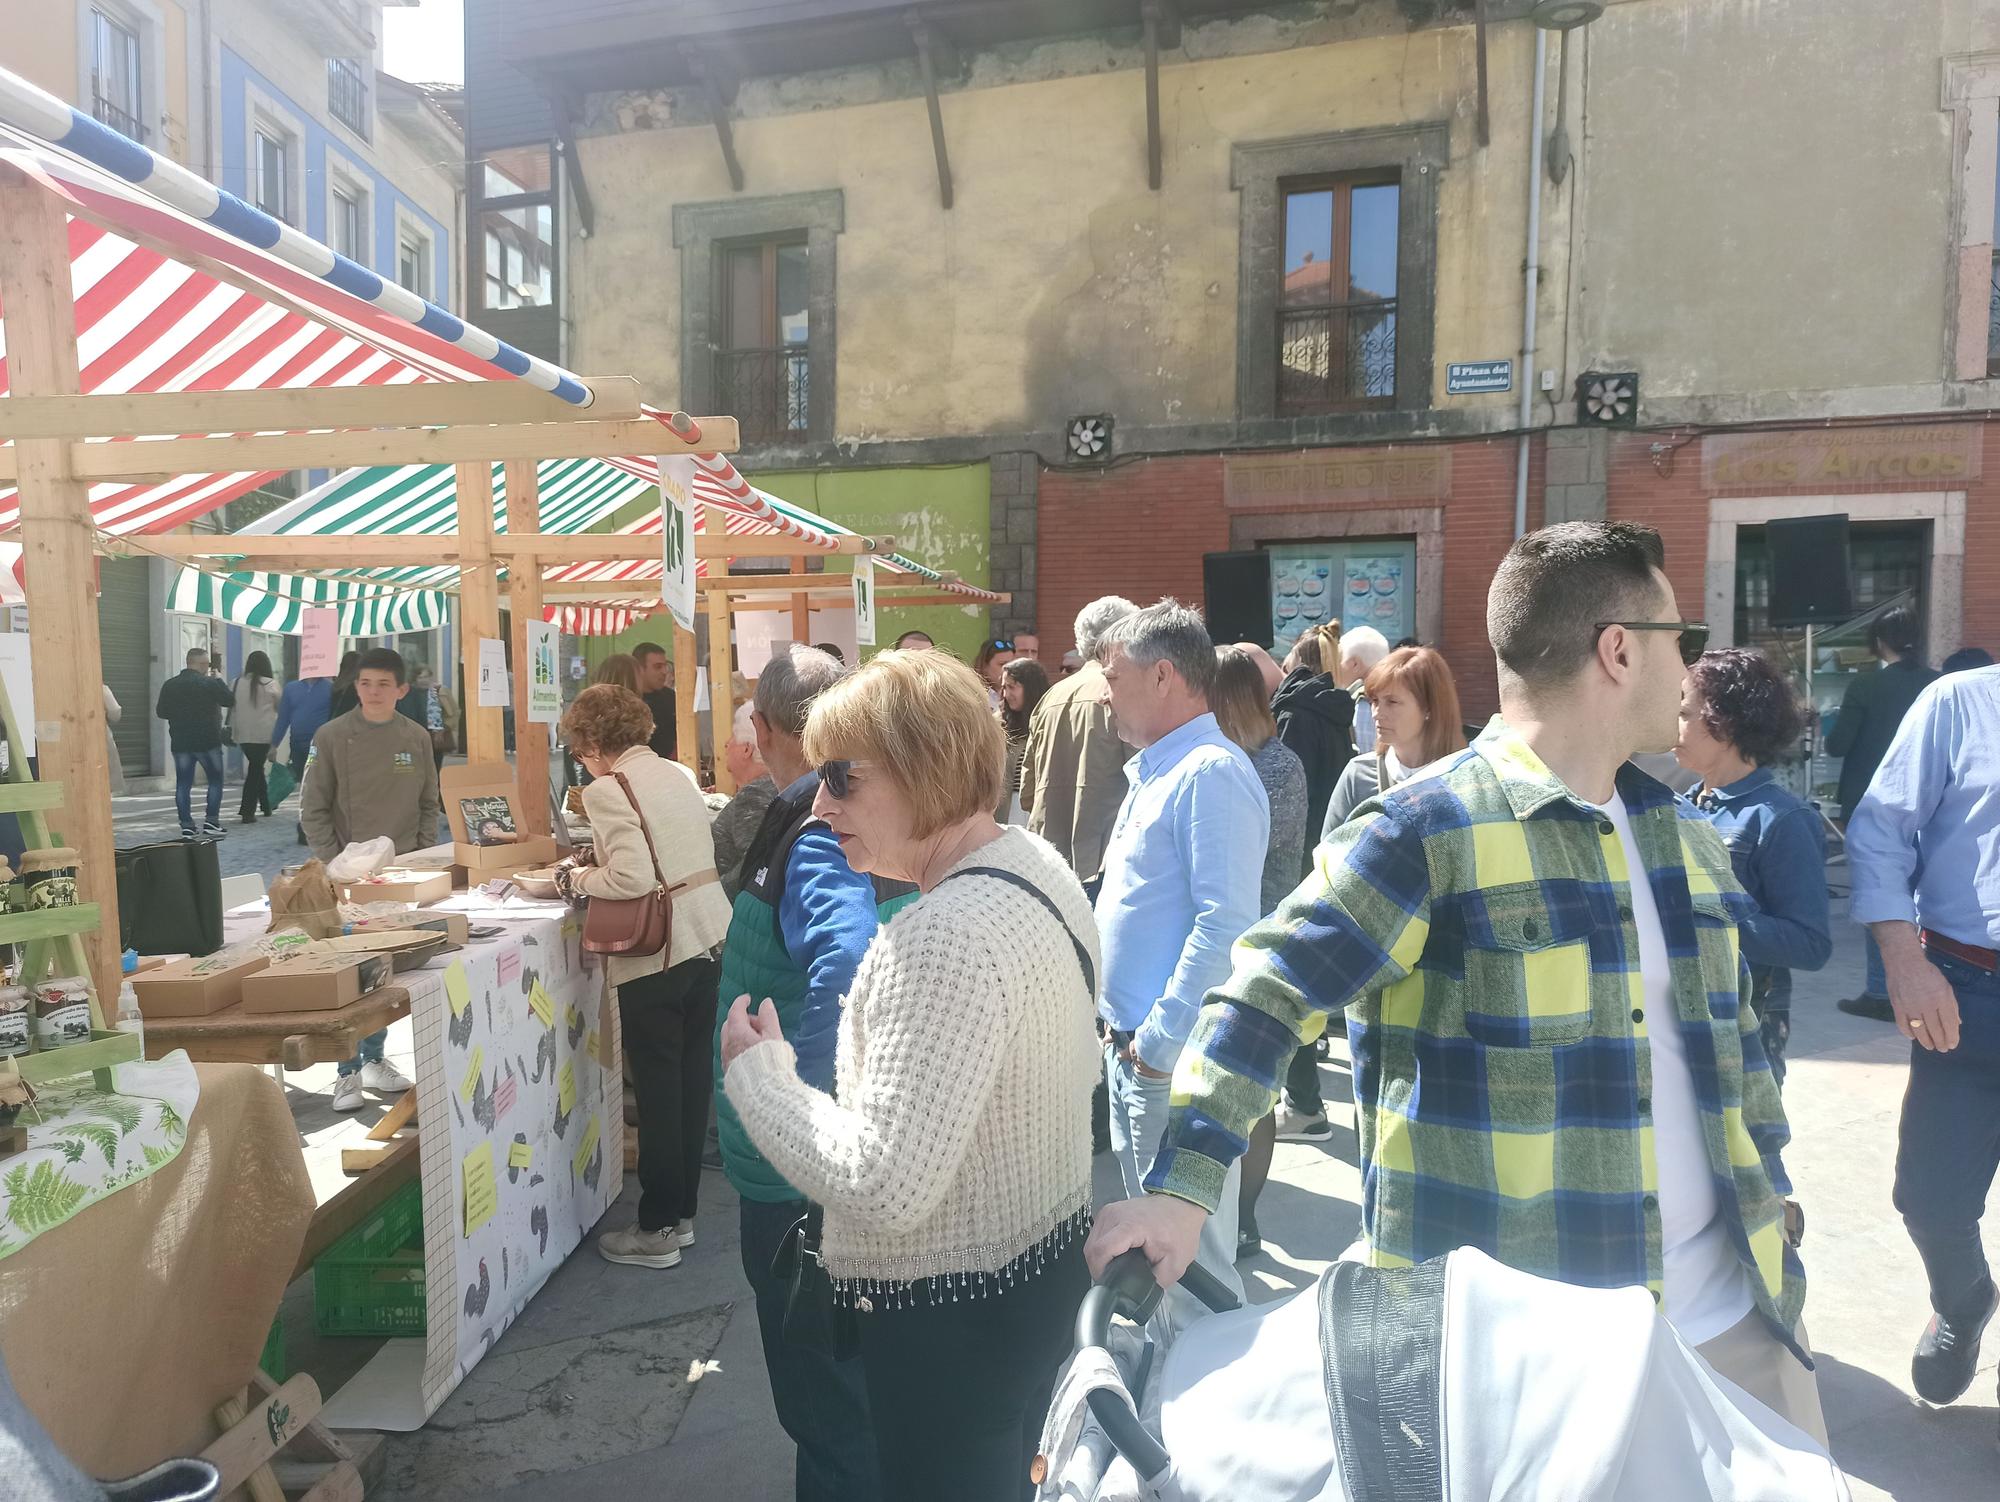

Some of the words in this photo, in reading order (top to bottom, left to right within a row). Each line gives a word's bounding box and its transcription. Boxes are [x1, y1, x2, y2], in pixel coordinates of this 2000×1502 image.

[1461, 366, 1490, 376] Plaza
[1492, 364, 1508, 374] del
[1450, 377, 1508, 389] Ayuntamiento
[1807, 428, 1968, 447] COMPLEMENTOS
[1817, 447, 1969, 480] Arcos
[533, 687, 557, 702] Alimentos
